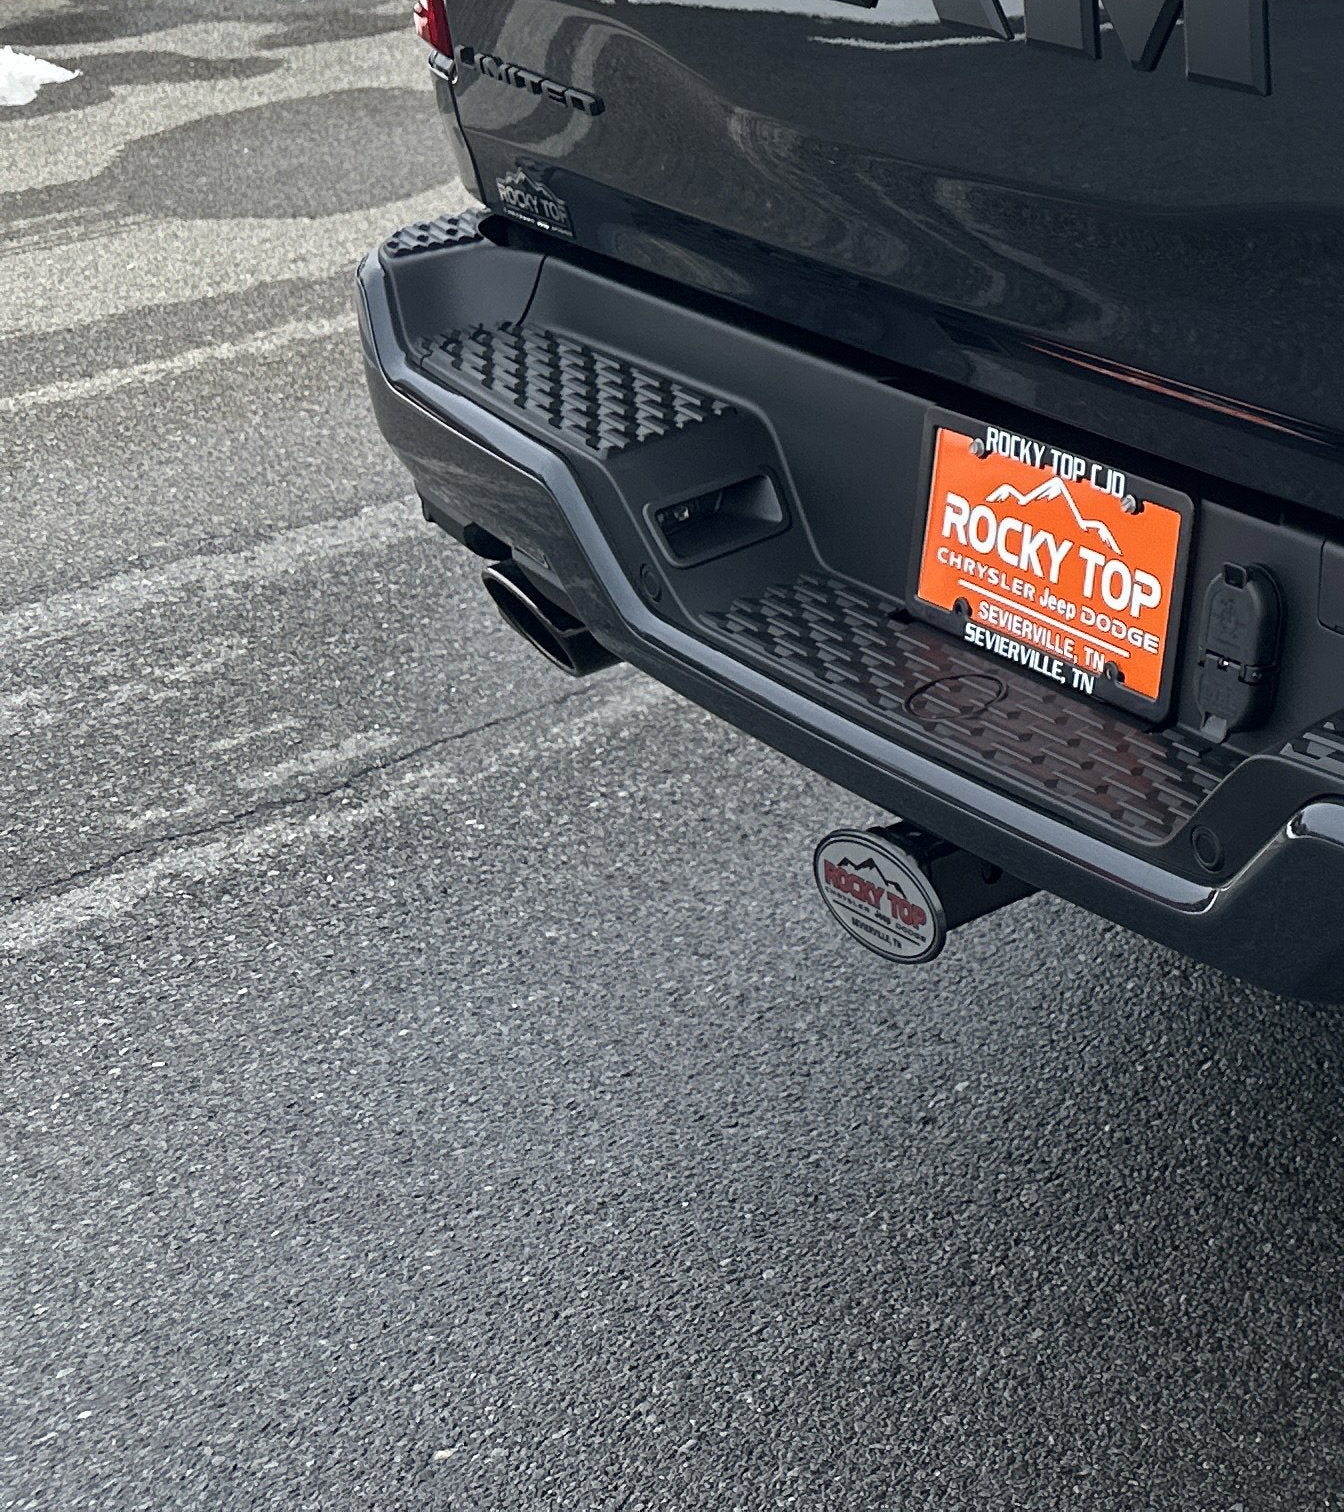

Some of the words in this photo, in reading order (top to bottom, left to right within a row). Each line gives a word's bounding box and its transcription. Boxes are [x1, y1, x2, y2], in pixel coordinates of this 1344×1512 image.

[454, 44, 606, 117] LIMITED
[985, 426, 1046, 469] ROCKY
[1051, 448, 1087, 484] TOP
[1090, 463, 1126, 499] CJD
[941, 491, 1074, 584] ROCKY
[1077, 545, 1162, 618] TOP
[936, 546, 1036, 602] CHRYSLER
[1038, 590, 1077, 621] Jeep
[1079, 607, 1161, 655] DODGE
[978, 600, 1079, 664] SEVIERVILLE,
[1083, 647, 1106, 674] TN
[964, 622, 1067, 685] SEVIERVILLE,
[1071, 667, 1097, 695] TN
[823, 859, 885, 908] ROCKY
[886, 892, 927, 928] TOP
